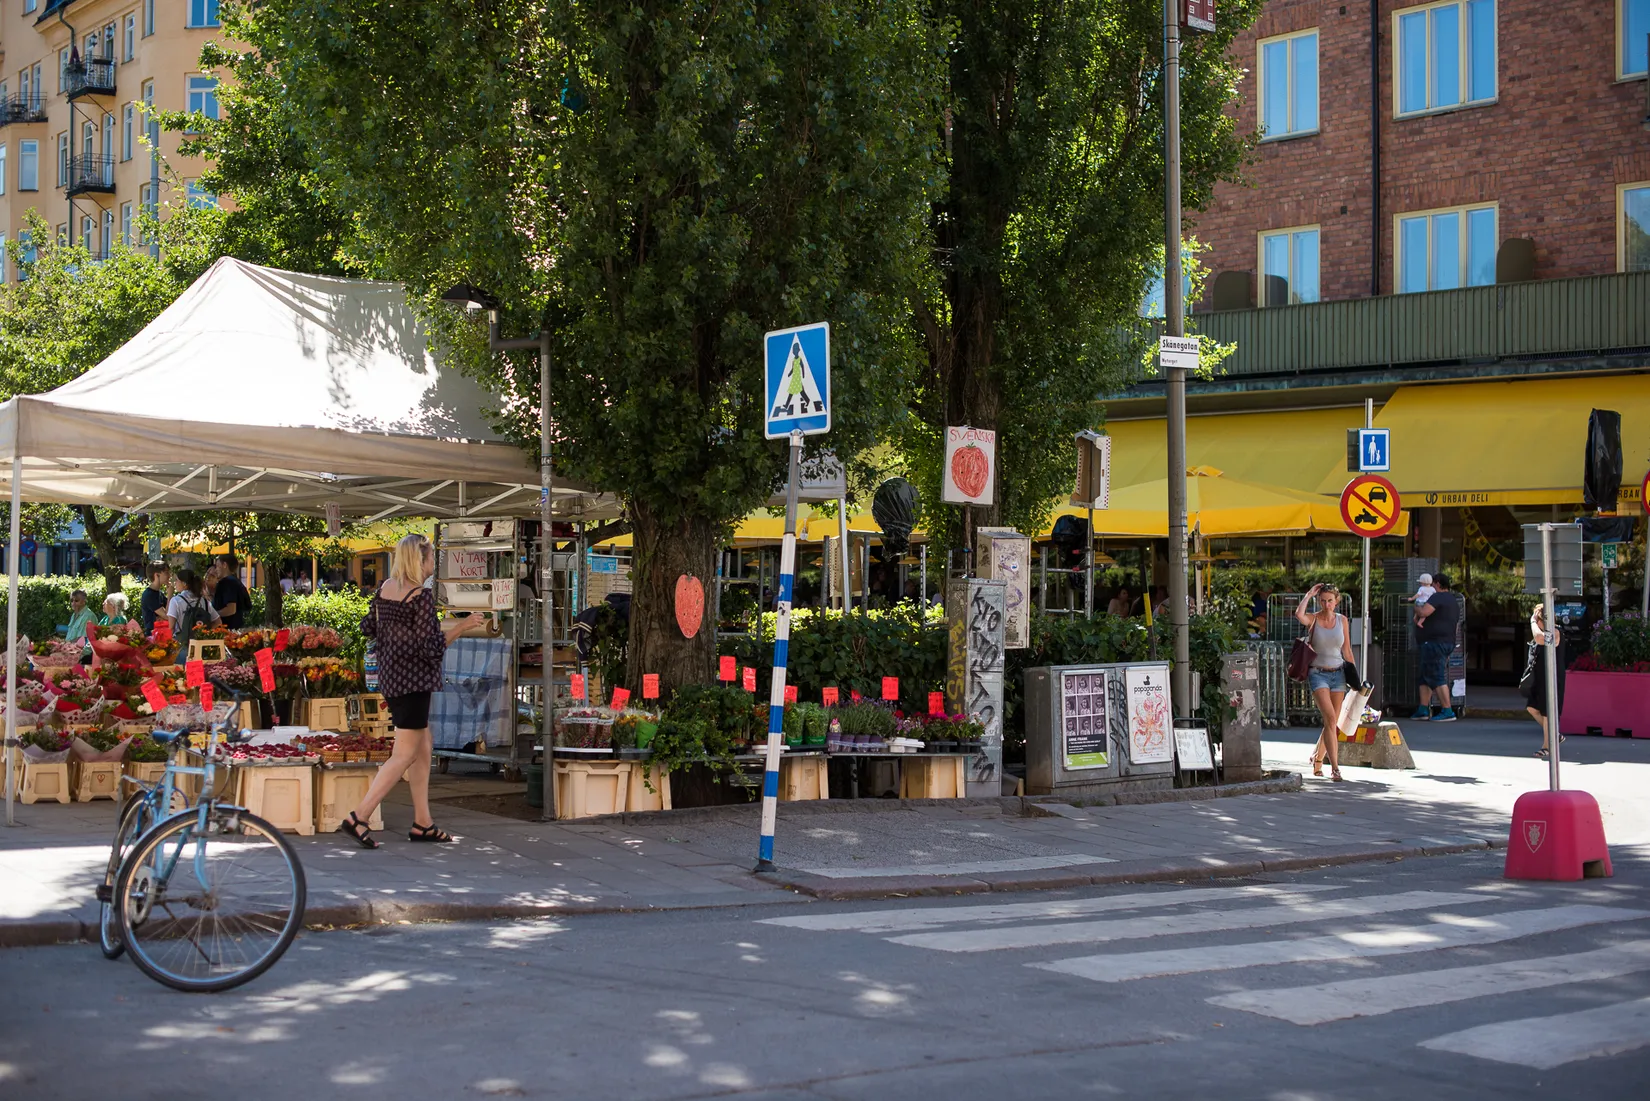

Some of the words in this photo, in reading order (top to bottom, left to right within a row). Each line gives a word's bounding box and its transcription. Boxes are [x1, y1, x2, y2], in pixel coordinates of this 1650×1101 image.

[1162, 339, 1198, 351] Skånegatan
[949, 429, 994, 444] SVENSKA
[1442, 494, 1468, 504] URBAN
[1471, 493, 1489, 503] DELI
[1618, 489, 1640, 499] RBAN
[466, 552, 487, 564] TAR
[459, 565, 486, 577] KORT
